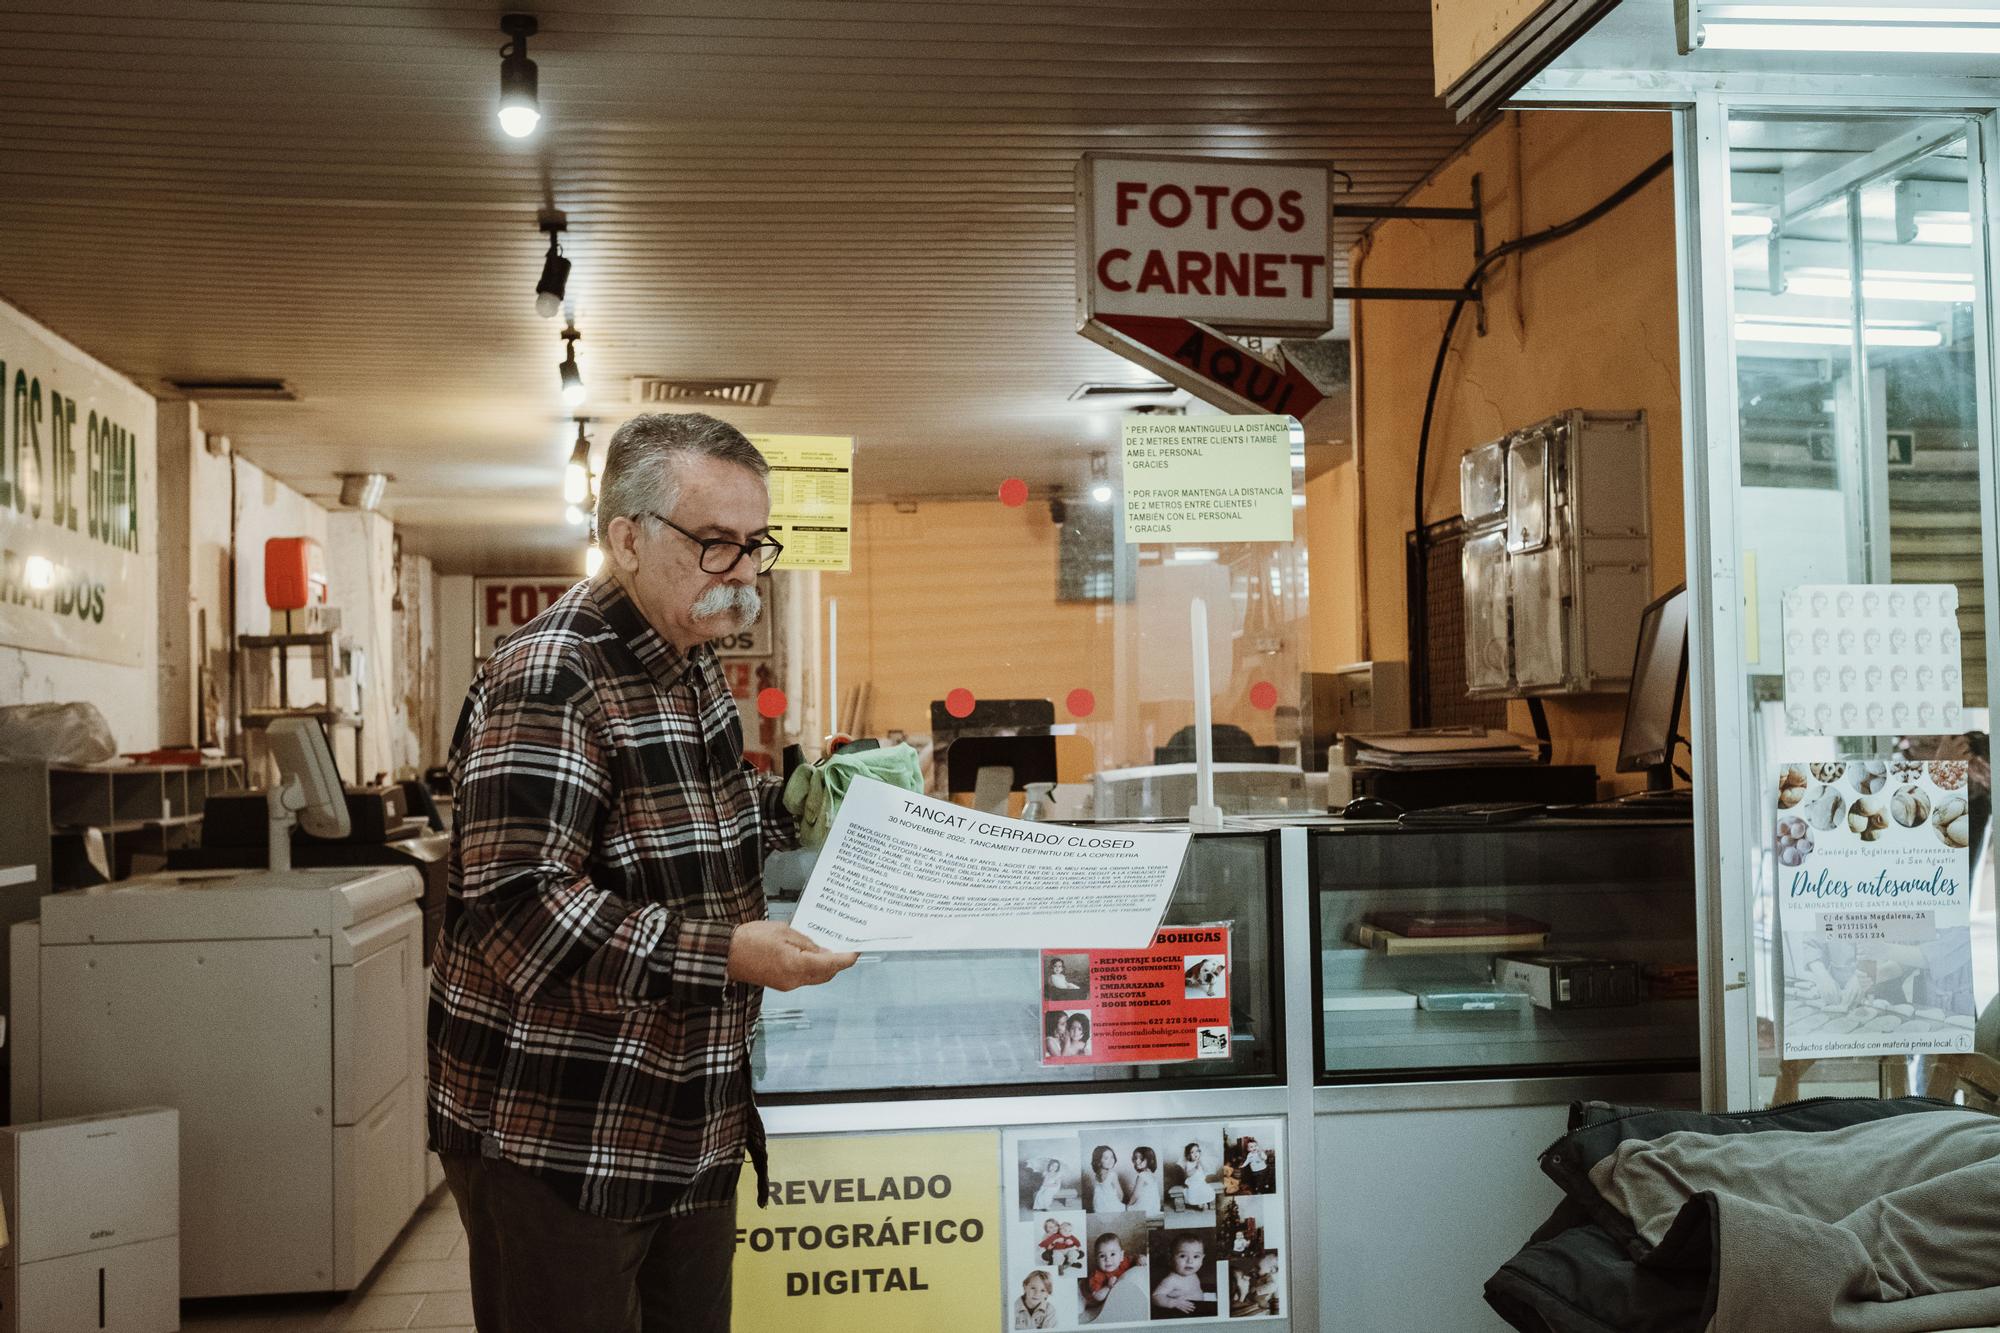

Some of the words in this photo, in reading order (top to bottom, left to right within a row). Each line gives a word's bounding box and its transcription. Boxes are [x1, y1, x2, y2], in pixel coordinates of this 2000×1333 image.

[1116, 182, 1305, 233] FOTOS
[1097, 248, 1325, 299] CARNET
[1131, 425, 1147, 434] PER
[1149, 425, 1177, 434] FAVOR
[1178, 424, 1232, 433] MANTINGUEU
[1233, 424, 1245, 433] LA
[1126, 437, 1139, 446] DE
[1139, 437, 1145, 446] 2
[1146, 437, 1180, 446] METRES
[1181, 436, 1208, 445] ENTRE
[1209, 435, 1244, 444] CLIENTS
[1126, 449, 1145, 457] AMB
[1147, 449, 1158, 457] EL
[1159, 448, 1203, 457] PERSONAL
[51, 389, 78, 532] DE
[87, 408, 139, 553] GOMA
[1133, 490, 1151, 498] POR
[1152, 489, 1180, 498] FAVOR
[1181, 488, 1227, 497] MANTENGA
[1228, 488, 1240, 496] LA
[1241, 487, 1284, 497] DISTANCIA
[1128, 501, 1140, 510] DE
[1141, 501, 1147, 510] 2
[1148, 501, 1182, 510] METROS
[1184, 500, 1211, 509] ENTRE
[1213, 499, 1252, 508] CLIENTES
[1166, 512, 1185, 521] CON
[1186, 512, 1197, 520] EL
[1198, 511, 1242, 520] PERSONAL
[1134, 524, 1172, 534] GRACIAS
[904, 800, 967, 828] TANCAT
[1067, 836, 1135, 849] CLOSED
[849, 822, 891, 841] BENVOLGUTS
[892, 836, 918, 849] CLIENTS
[856, 832, 887, 848] MATERIAL
[888, 815, 898, 824] 30
[899, 819, 945, 838] NOVEMBRE
[969, 838, 1020, 853] TANCAMENT
[1021, 847, 1061, 857] DEFINITIU
[1907, 857, 1922, 865] San
[1791, 867, 1852, 899] Dulces
[1857, 865, 1960, 898] artesanales
[1834, 913, 1843, 921] de
[1845, 913, 1868, 921] Santa
[1915, 911, 1926, 919] 2A
[1156, 932, 1221, 944] BOHIGAS
[1100, 957, 1150, 966] REPORTAJE
[1151, 955, 1183, 963] SOCIAL
[1100, 981, 1165, 990] EMBARAZADAS
[1100, 991, 1147, 999] MASCOTAS
[1101, 1000, 1128, 1008] BOOK
[1128, 999, 1172, 1007] MODELOS
[1824, 1041, 1866, 1050] elaborados
[1882, 1040, 1910, 1048] materia
[1910, 1039, 1933, 1050] prima
[767, 1174, 952, 1206] REVELADO
[786, 1267, 929, 1297] DIGITAL
